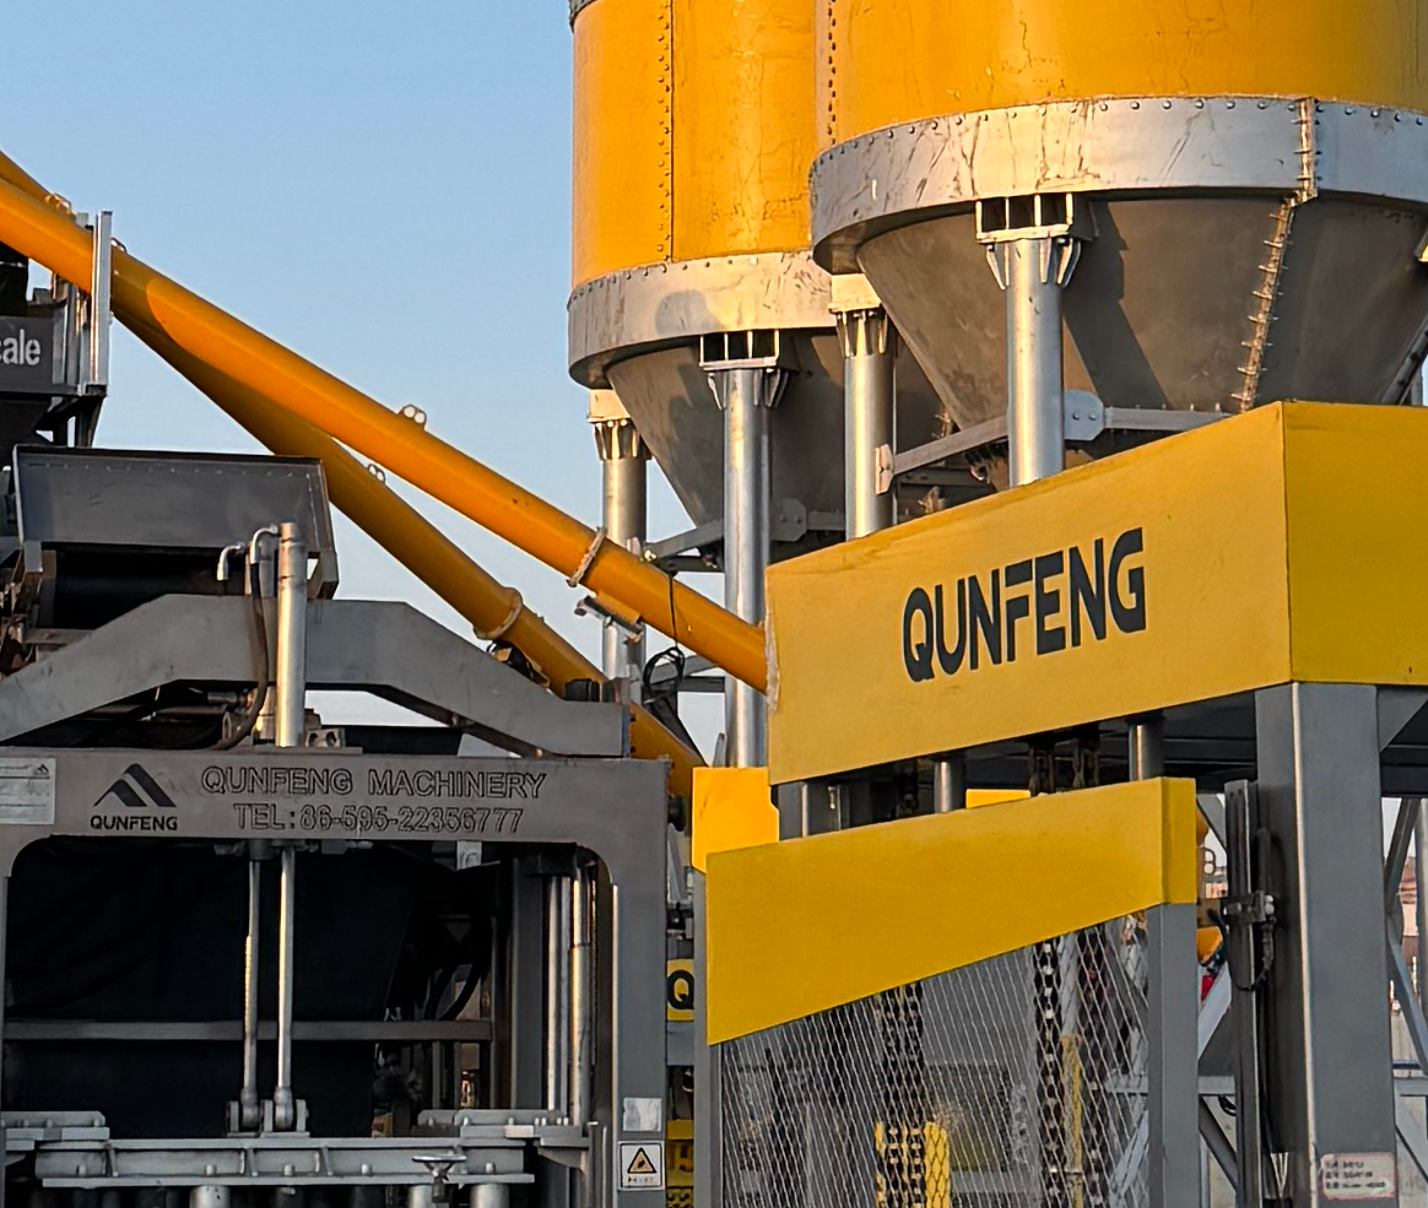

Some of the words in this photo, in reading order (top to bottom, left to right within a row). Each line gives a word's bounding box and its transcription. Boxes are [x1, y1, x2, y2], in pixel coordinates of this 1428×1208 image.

[903, 527, 1147, 683] QUNFENG
[201, 765, 353, 795] QUNFENG
[368, 768, 547, 799] MACHINERY
[90, 815, 178, 831] QUNFENG
